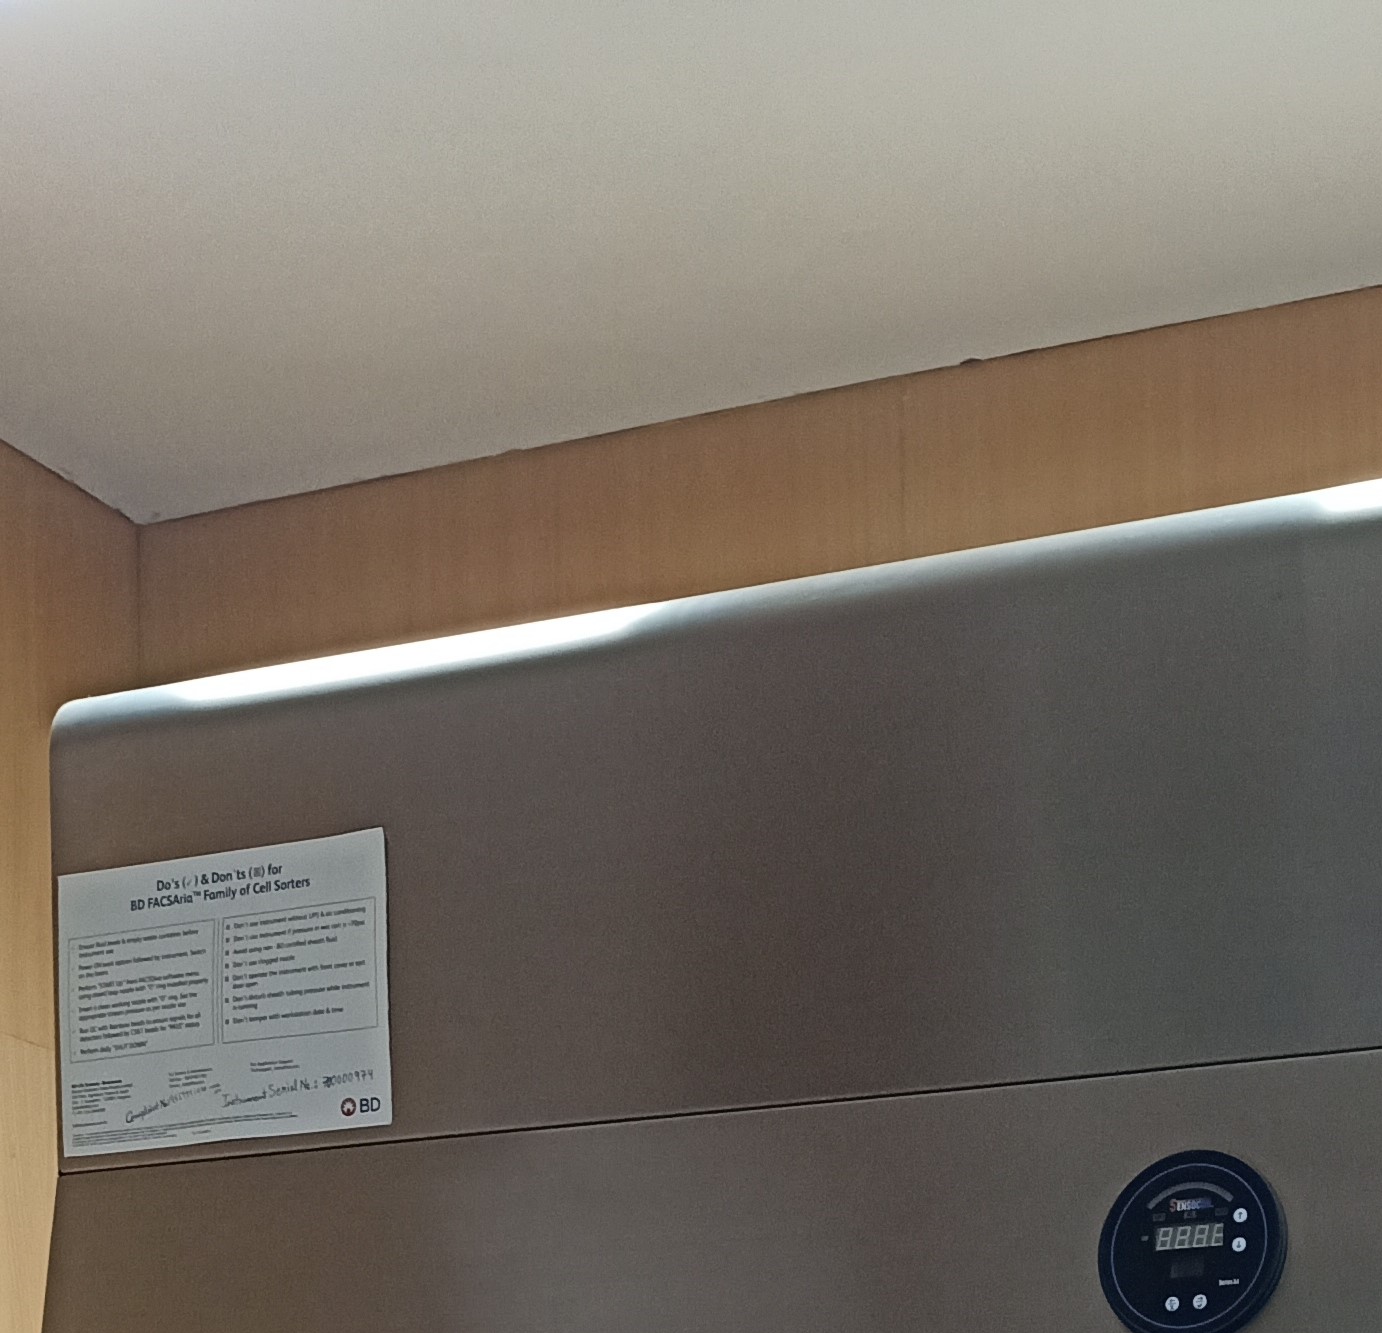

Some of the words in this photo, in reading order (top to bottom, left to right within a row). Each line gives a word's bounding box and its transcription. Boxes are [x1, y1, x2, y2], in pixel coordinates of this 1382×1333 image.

[156, 878, 180, 892] Do's
[201, 874, 209, 885] &
[267, 863, 283, 876] for
[130, 899, 145, 912] BD
[203, 886, 237, 901] Family
[239, 884, 251, 896] of
[252, 881, 271, 895] Cell
[274, 877, 311, 892] Sorters
[359, 1097, 381, 1113] BD
